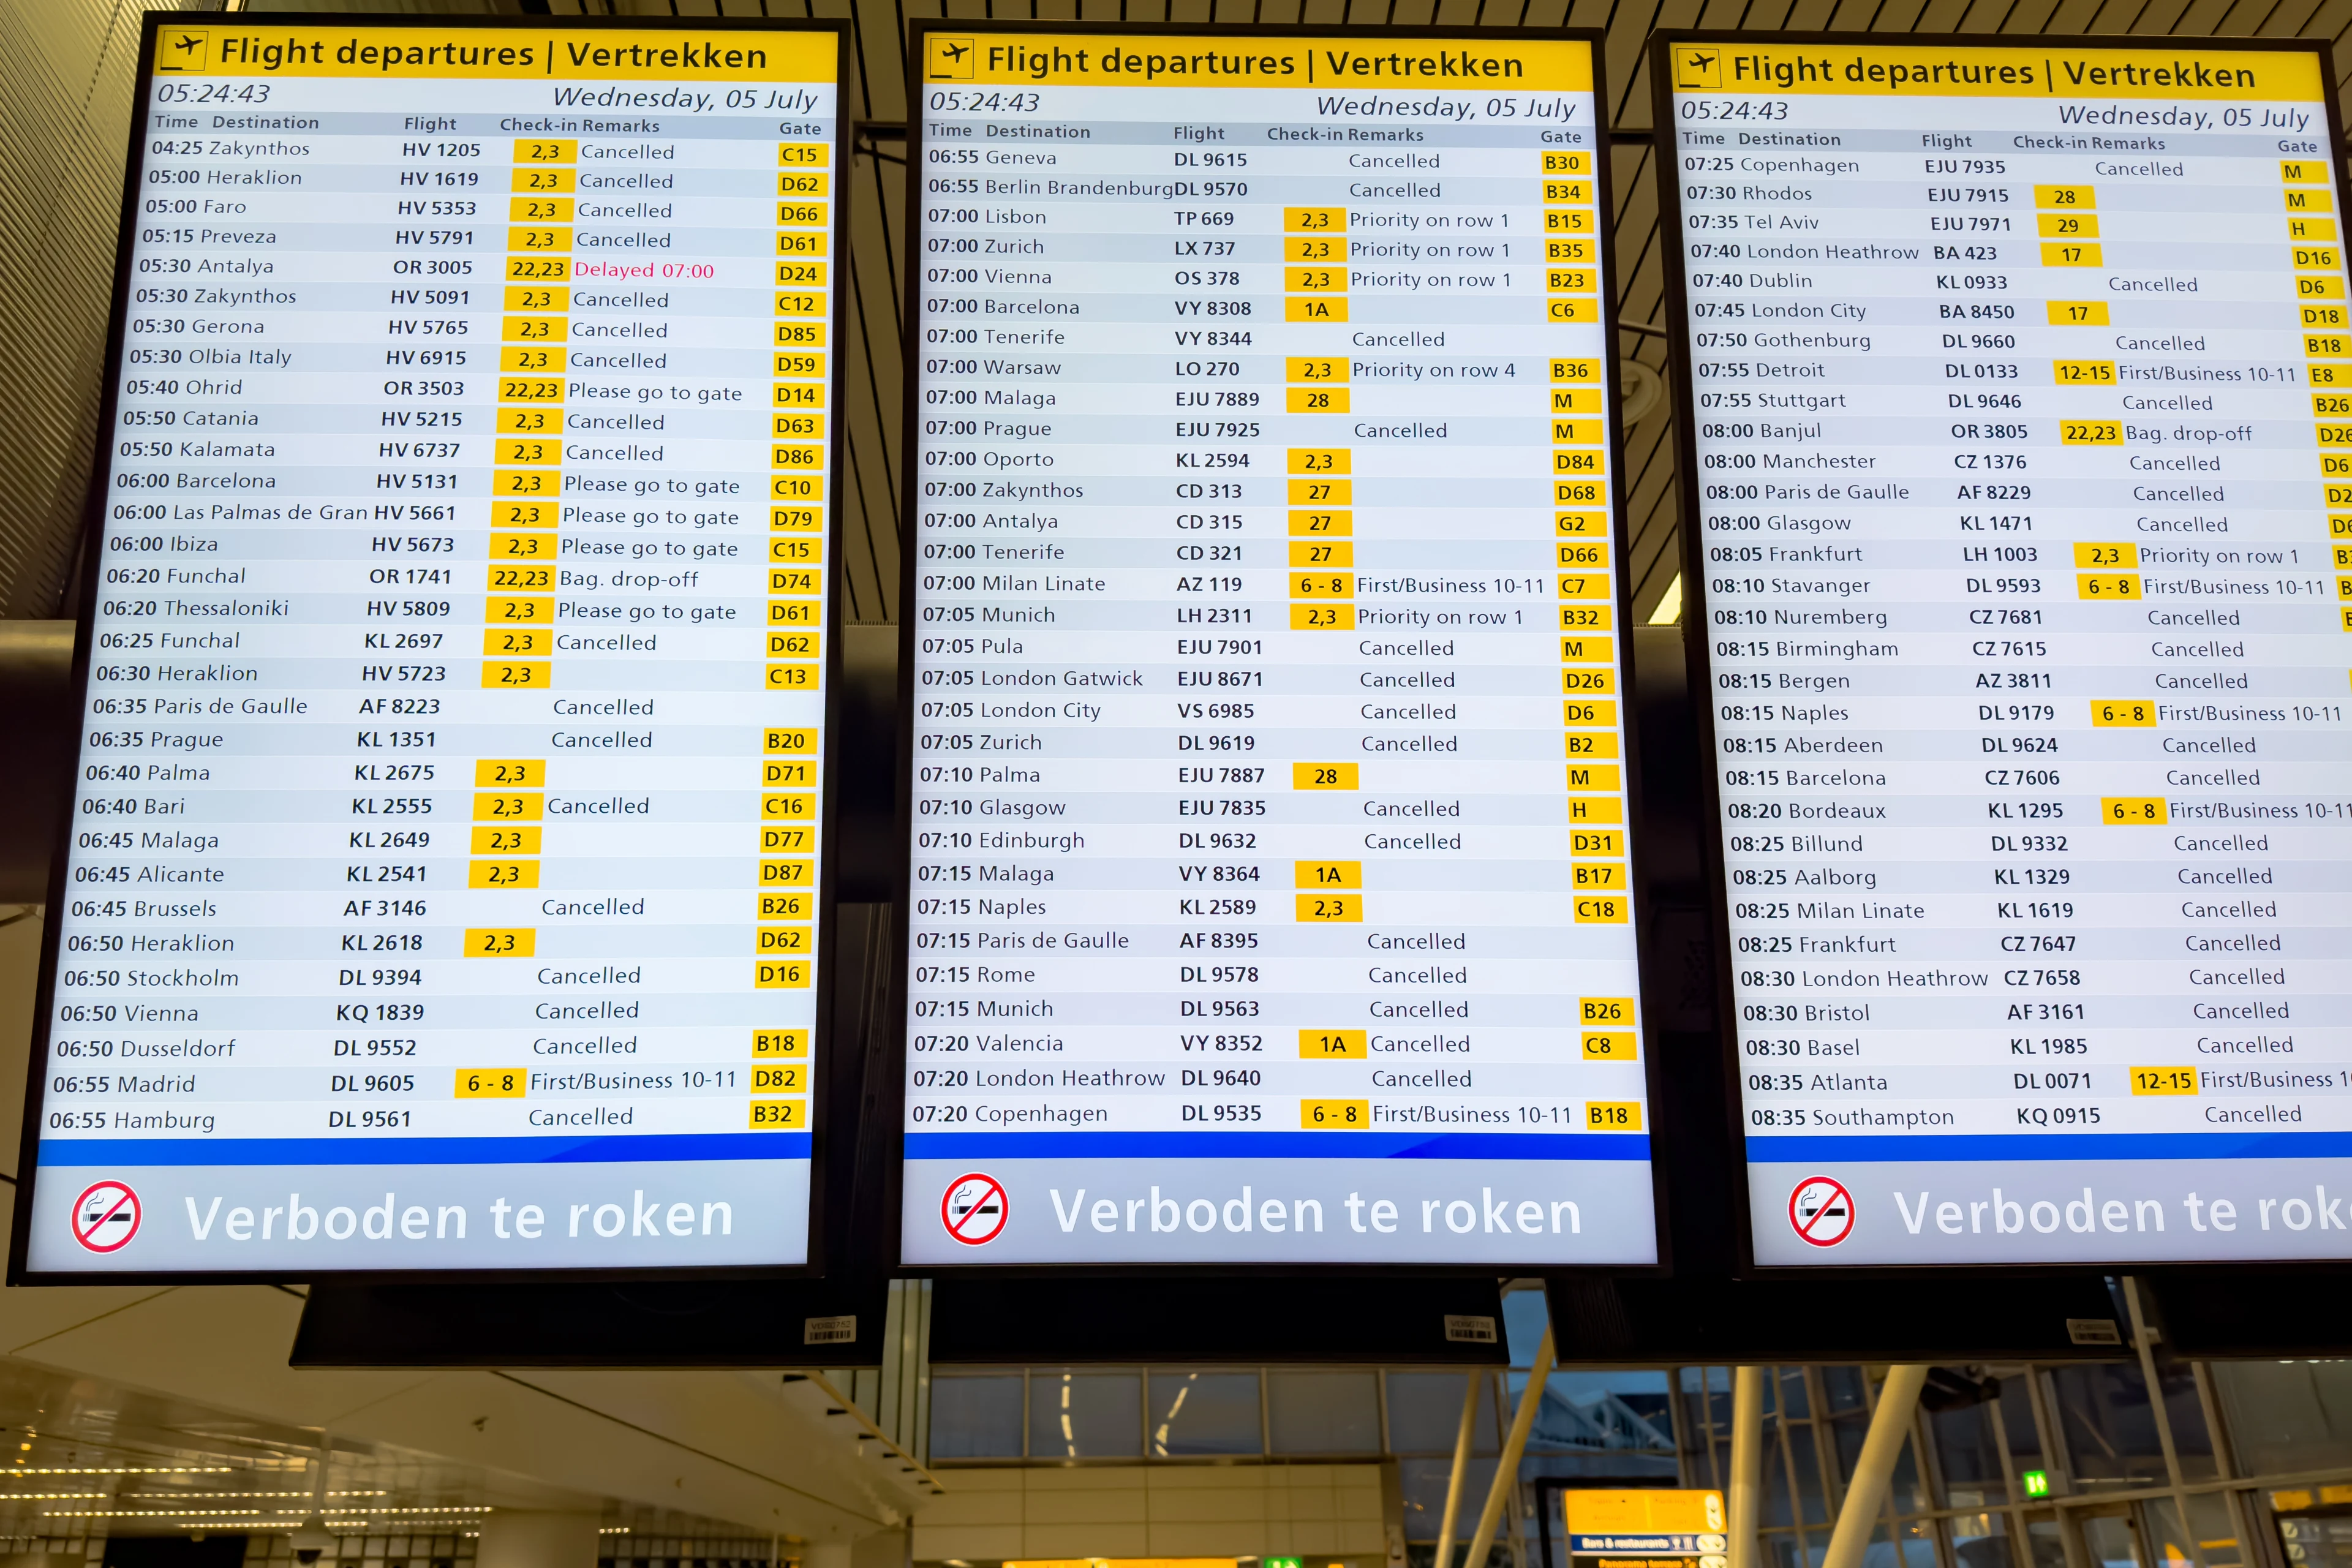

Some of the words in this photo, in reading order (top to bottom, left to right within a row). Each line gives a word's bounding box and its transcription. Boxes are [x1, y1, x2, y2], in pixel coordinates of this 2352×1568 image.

[221, 37, 325, 71] Flight
[336, 38, 533, 72] departures
[567, 41, 766, 69] Vertrekken
[989, 45, 1089, 80] Flight
[1101, 47, 1295, 80] departures
[1325, 50, 1523, 78] Vertrekken
[1734, 55, 1834, 88] Flight
[1845, 56, 2034, 89] departures
[2064, 59, 2256, 88] Vertrekken
[157, 83, 271, 104] 05:24:43
[554, 86, 715, 113] Wednesday,
[726, 89, 758, 108] 05
[764, 89, 818, 115] July
[930, 91, 1040, 112] 05:24:43
[1317, 95, 1476, 122] Wednesday,
[1487, 98, 1517, 117] 05
[1523, 97, 1577, 123] July
[1681, 100, 1789, 121] 05:24:43
[2059, 104, 2213, 131] Wednesday,
[2223, 108, 2252, 127] 05
[2260, 107, 2310, 133] July
[154, 114, 198, 128] Time
[213, 115, 319, 129] Destination
[405, 116, 457, 134] Flight
[500, 117, 577, 132] Check-in
[582, 118, 660, 132] Remarks
[780, 122, 821, 135] Gate
[929, 123, 972, 137] Time
[987, 124, 1090, 138] Destination
[1174, 126, 1225, 143] Flight
[1267, 127, 1343, 141] Check-in
[1348, 127, 1424, 141] Remarks
[1541, 130, 1581, 143] Gate
[152, 141, 203, 155] 04:25
[209, 140, 309, 159] Zakynthos
[403, 143, 431, 157] HV
[437, 143, 481, 157] 1205
[531, 145, 559, 160] 2,3
[581, 144, 674, 159] Cancelled
[782, 148, 817, 162] C15
[1682, 131, 1725, 145] Time
[1739, 132, 1841, 146] Destination
[1922, 134, 1973, 151] Flight
[2013, 135, 2087, 149] Check-in
[2092, 137, 2166, 150] Remarks
[2278, 140, 2318, 153] Gate
[929, 149, 979, 164] 06:55
[986, 150, 1056, 165] Geneva
[1175, 153, 1199, 167] DL
[1204, 153, 1247, 167] 9615
[1349, 153, 1439, 168] Cancelled
[1545, 156, 1579, 170] B30
[1687, 186, 1736, 200] 07:30
[1743, 185, 1812, 200] Rhodos
[1928, 188, 1961, 202] EJU
[1965, 189, 2009, 203] 7915
[2054, 190, 2076, 204] 28
[2288, 193, 2305, 207] M
[929, 208, 979, 223] 07:00
[986, 208, 1046, 224] Lisbon
[1174, 211, 1197, 225] TP
[1201, 211, 1234, 226] 669
[1302, 213, 1329, 230] 2,3
[1351, 213, 1420, 231] Priority
[1426, 216, 1449, 228] on
[1457, 216, 1493, 228] row
[1501, 214, 1507, 228] 1
[1548, 214, 1582, 228] B15
[140, 258, 191, 273] 05:30
[197, 258, 273, 277] Antalya
[393, 260, 422, 274] OR
[426, 260, 472, 274] 3005
[513, 262, 564, 279] 22,23
[575, 261, 654, 281] Delayed
[663, 263, 714, 279] 07:00
[780, 266, 818, 281] D24
[1698, 363, 1749, 377] 07:55
[1757, 363, 1826, 377] Detroit
[1945, 364, 1971, 379] DL
[1975, 364, 2018, 379] 0133
[2060, 365, 2110, 380] 12-15
[2119, 365, 2242, 381] First/Business
[2248, 367, 2294, 382] 10-11
[2312, 368, 2334, 382] E8
[1703, 423, 1754, 439] 08:00
[1761, 422, 1821, 442] Banjul
[1951, 424, 1980, 439] OR
[1984, 424, 2028, 439] 3805
[2067, 425, 2116, 442] 22,23
[2126, 425, 2168, 444] Bag.
[2173, 424, 2252, 445] drop-off
[2320, 428, 2352, 442] D26
[113, 505, 167, 519] 06:00
[174, 505, 204, 519] Las
[211, 503, 281, 520] Palmas
[288, 503, 312, 520] de
[320, 505, 368, 520] Gran
[374, 505, 405, 520] HV
[409, 505, 454, 521] 5661
[510, 507, 540, 525] 2,3
[564, 506, 626, 523] Please
[633, 512, 659, 528] go
[665, 510, 687, 524] to
[694, 511, 739, 529] gate
[775, 511, 812, 526] D79
[1716, 641, 1770, 657] 08:15
[1777, 639, 1898, 661] Birmingham
[1972, 641, 1997, 656] CZ
[2000, 641, 2046, 656] 7615
[2152, 641, 2244, 657] Cancelled
[922, 670, 974, 685] 07:05
[982, 669, 1056, 686] London
[1063, 669, 1144, 686] Gatwick
[1178, 671, 1212, 687] EJU
[1218, 671, 1262, 687] 8671
[1360, 671, 1455, 688] Cancelled
[1566, 673, 1604, 688] D26
[918, 865, 971, 881] 07:15
[979, 864, 1054, 886] Malaga
[1178, 865, 1208, 881] VY
[1213, 865, 1261, 882] 8364
[1316, 867, 1342, 883] 1A
[1577, 868, 1612, 884] B17
[1733, 869, 1787, 885] 08:25
[1794, 868, 1876, 890] Aalborg
[1994, 869, 2020, 884] KL
[2024, 869, 2070, 884] 1329
[2178, 867, 2272, 884] Cancelled
[914, 1035, 969, 1052] 07:20
[976, 1033, 1063, 1052] Valencia
[1180, 1035, 1210, 1051] VY
[1215, 1035, 1263, 1052] 8352
[1320, 1036, 1347, 1052] 1A
[1371, 1035, 1470, 1052] Cancelled
[1586, 1037, 1611, 1054] C8
[50, 1112, 106, 1129] 06:55
[115, 1110, 214, 1133] Hamburg
[329, 1110, 356, 1128] DL
[362, 1110, 410, 1128] 9561
[529, 1106, 633, 1126] Cancelled
[754, 1106, 792, 1123] B32
[1751, 1109, 1806, 1126] 08:35
[1813, 1107, 1954, 1130] Southampton
[2017, 1107, 2048, 1127] KQ
[2053, 1107, 2100, 1124] 0915
[2205, 1104, 2302, 1123] Cancelled
[184, 1192, 467, 1241] Verboden
[489, 1197, 545, 1239] te
[568, 1189, 732, 1238] roken
[1049, 1185, 1324, 1233] Verboden
[1344, 1191, 1398, 1234] te
[1422, 1186, 1581, 1234] roken
[1893, 1187, 2165, 1235] Verboden
[2183, 1191, 2237, 1232] te
[2258, 1185, 2352, 1231] rok
[1582, 1537, 1604, 1548] Bars
[1605, 1537, 1614, 1548] &
